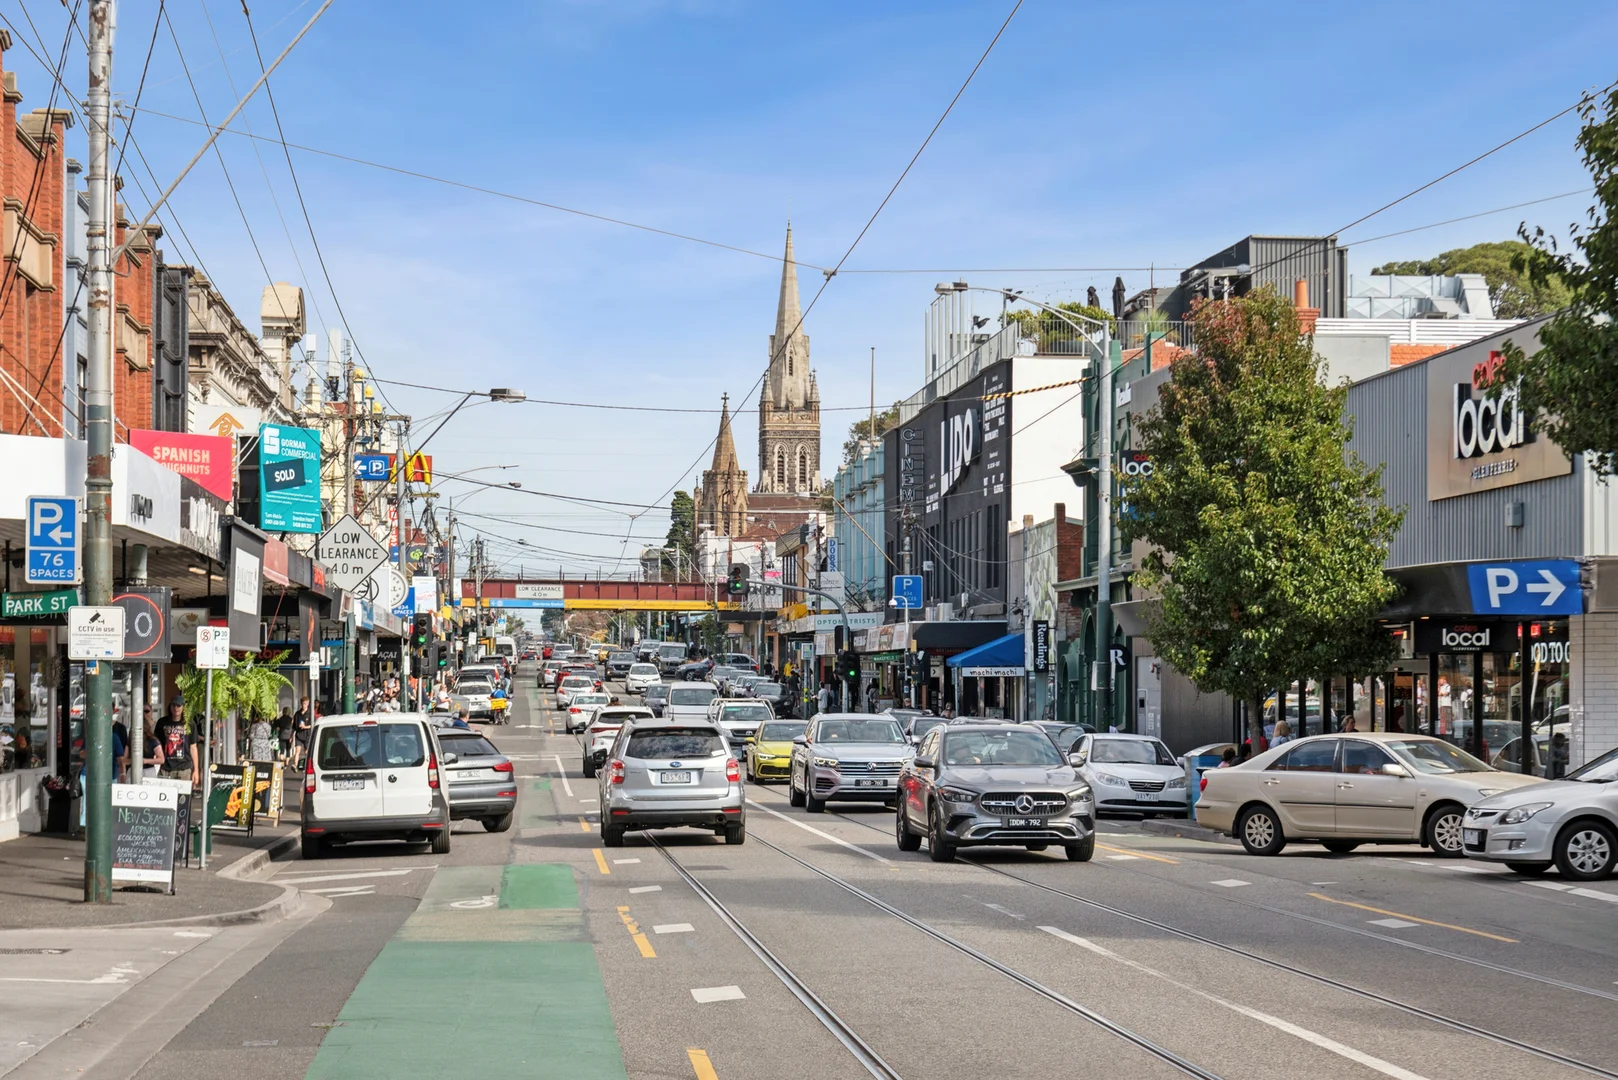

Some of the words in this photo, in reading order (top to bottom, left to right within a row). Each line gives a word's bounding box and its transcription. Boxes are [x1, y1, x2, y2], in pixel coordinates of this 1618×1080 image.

[1454, 373, 1525, 458] local
[281, 438, 306, 449] GORMAN
[153, 446, 210, 463] SPANISH
[281, 448, 317, 460] COMMERCIAL
[941, 408, 974, 497] LIDO
[274, 468, 295, 482] SOLD
[33, 502, 63, 536] P
[334, 533, 360, 544] LOW
[40, 553, 64, 566] 76
[321, 548, 379, 559] LEARANCE
[30, 569, 74, 578] SPACES
[330, 563, 348, 574] 4.0
[352, 566, 363, 574] m
[903, 578, 913, 590] P
[1486, 568, 1519, 608] P
[6, 598, 43, 614] PARK
[51, 596, 68, 610] ST
[817, 618, 876, 626] OPTOMTRISTS
[1442, 628, 1490, 646] local
[1035, 623, 1047, 670] Readings
[377, 651, 398, 660] AÇAI
[1110, 649, 1127, 666] R
[969, 667, 993, 676] machi
[994, 667, 1017, 676] machi
[117, 790, 149, 801] ECO
[270, 773, 281, 813] LUNCH
